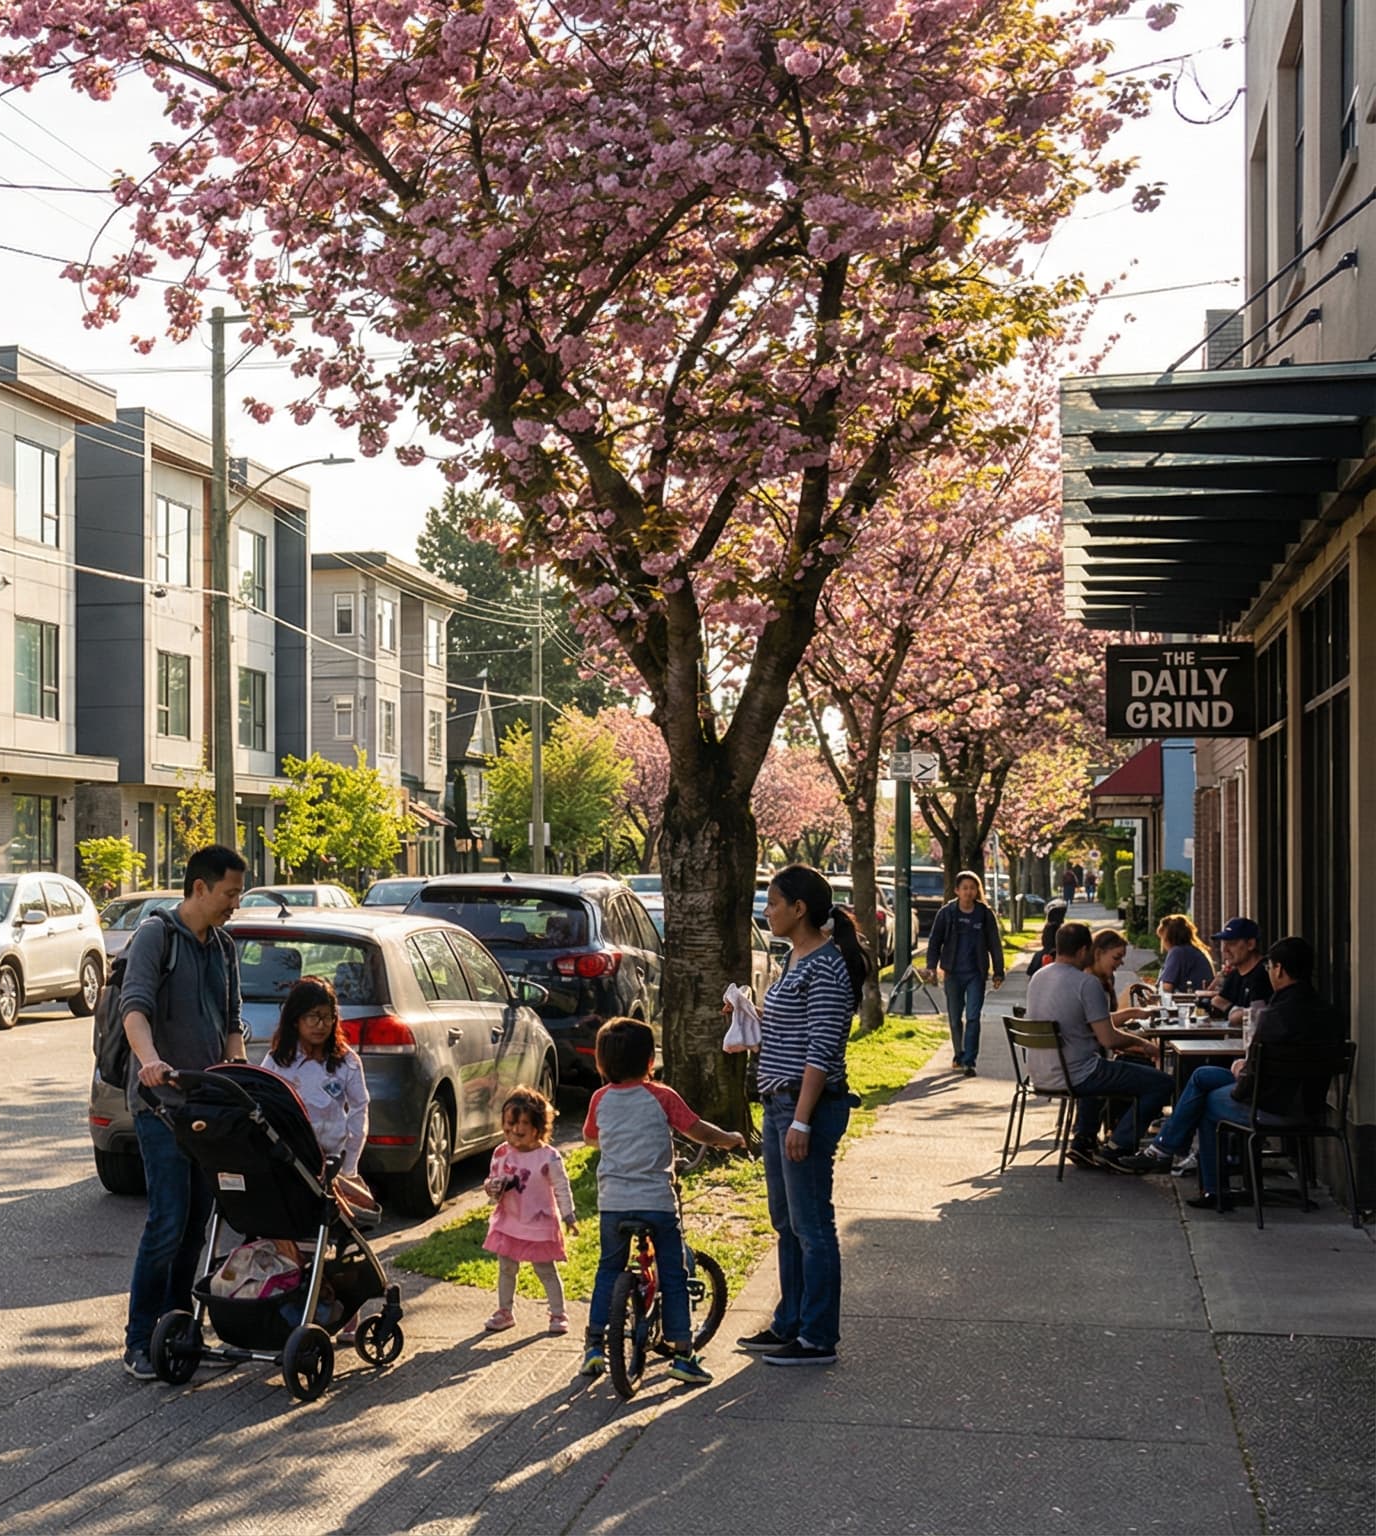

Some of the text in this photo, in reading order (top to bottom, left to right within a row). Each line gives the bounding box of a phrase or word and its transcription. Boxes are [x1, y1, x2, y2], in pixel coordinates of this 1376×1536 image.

[1162, 651, 1195, 665] THE
[1131, 668, 1228, 697] DAILY
[1125, 701, 1234, 729] GRIND
